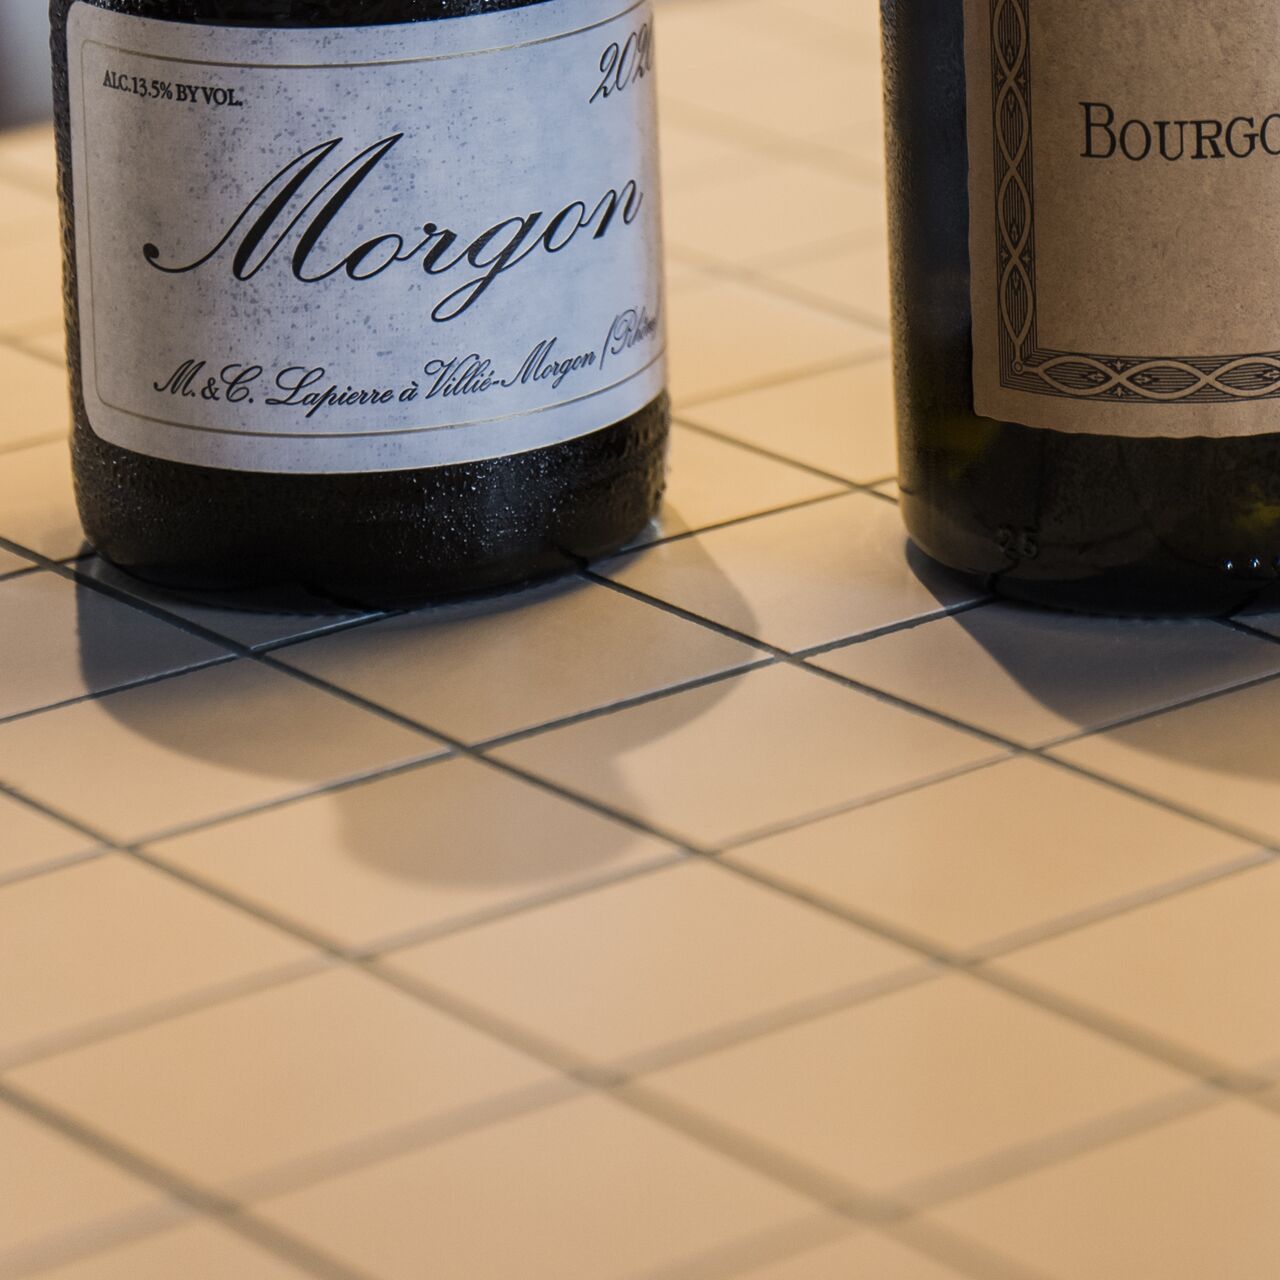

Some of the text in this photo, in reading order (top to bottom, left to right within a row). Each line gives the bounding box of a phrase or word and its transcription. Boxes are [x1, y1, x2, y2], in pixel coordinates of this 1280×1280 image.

[201, 87, 244, 107] VOL.
[143, 132, 643, 323] Morgon
[265, 366, 395, 418] Lapierre
[398, 381, 419, 403] à
[424, 336, 597, 401] Villié-Morgon
